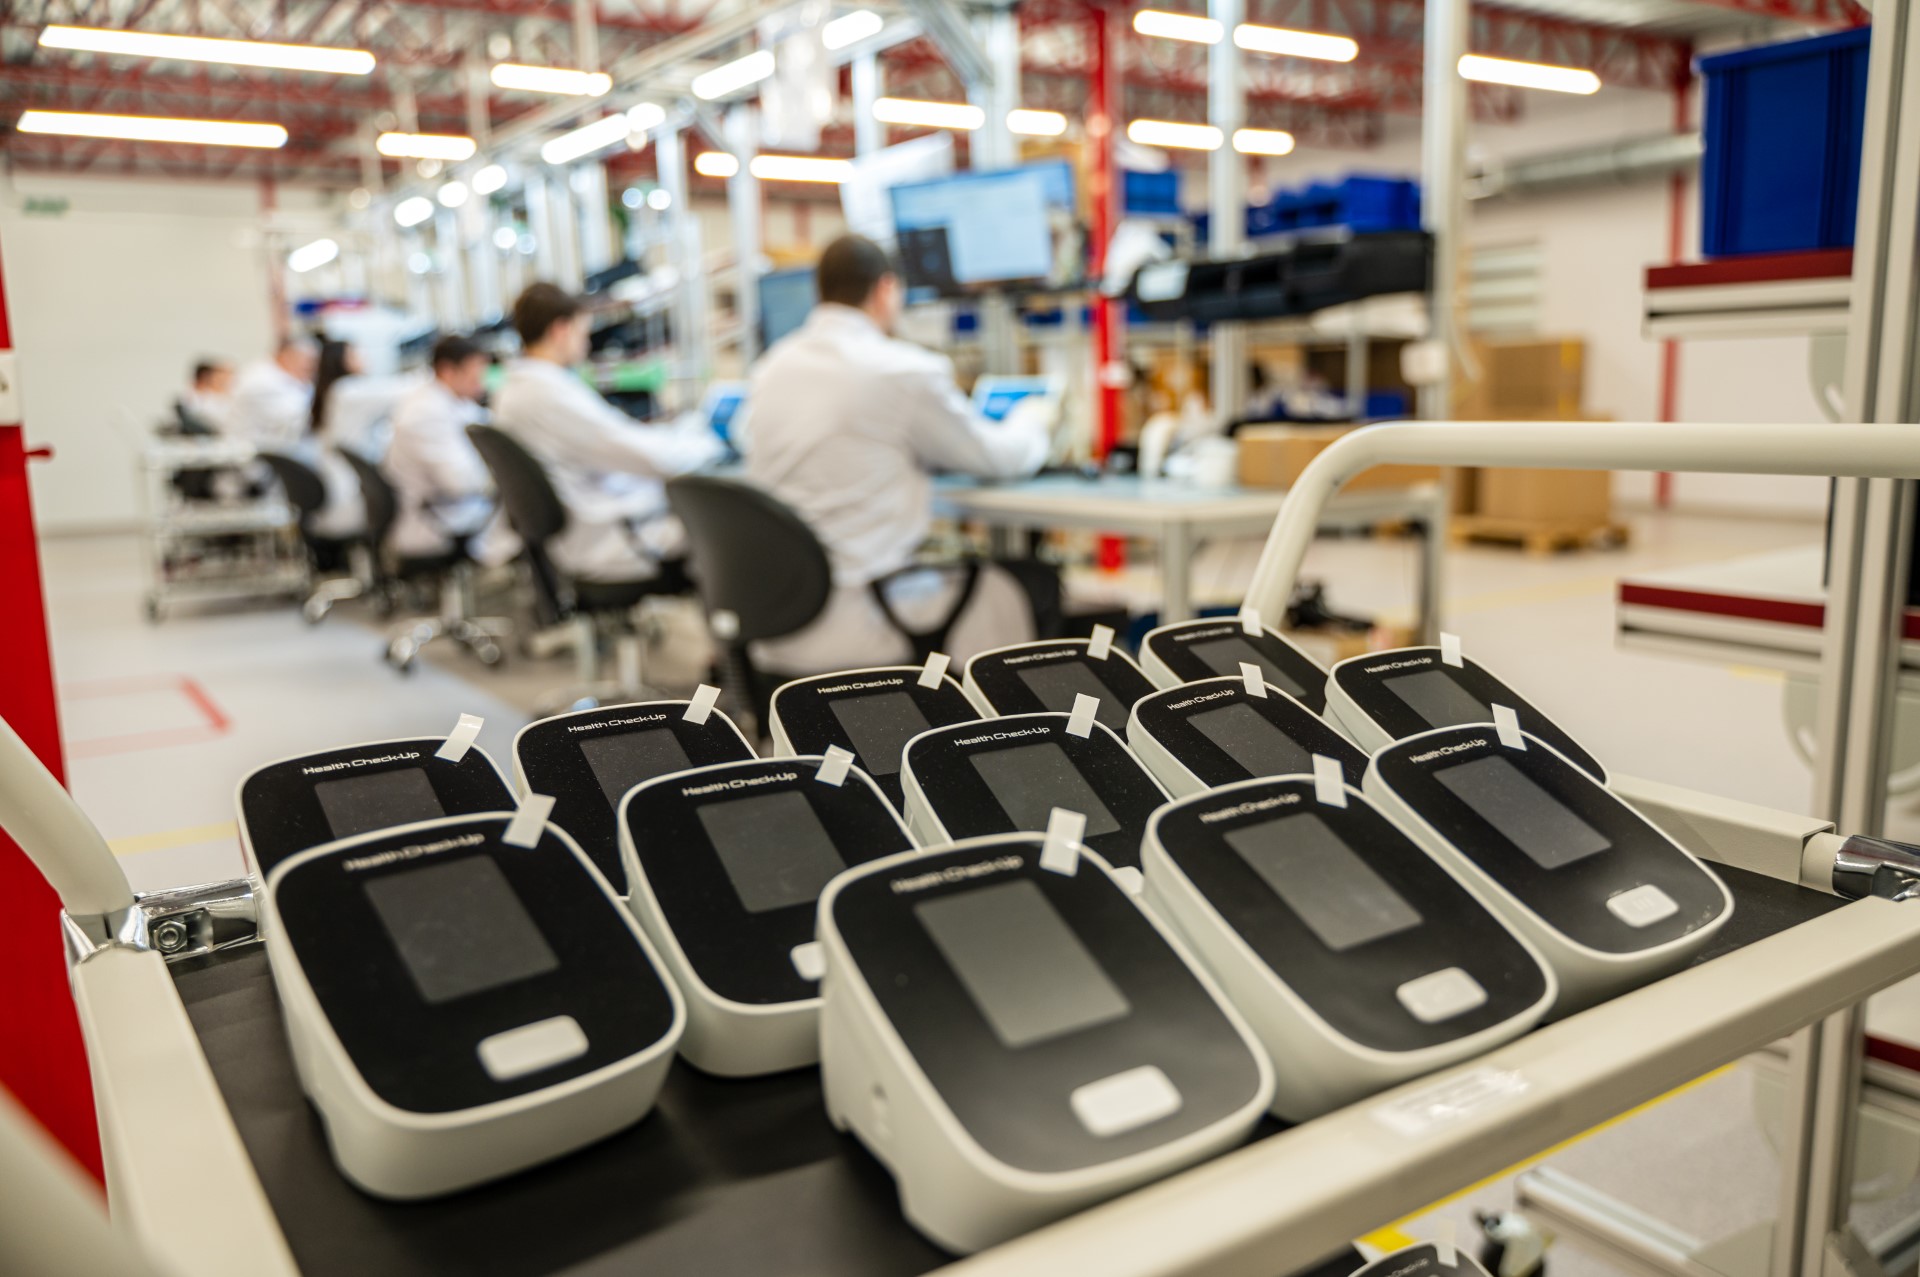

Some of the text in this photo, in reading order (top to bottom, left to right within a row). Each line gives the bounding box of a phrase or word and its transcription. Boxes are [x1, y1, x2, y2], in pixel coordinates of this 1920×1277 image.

[817, 678, 904, 694] Health Check-Up
[1167, 689, 1235, 710] Health Check-Up
[567, 714, 667, 733] Health Check-Up
[954, 727, 1050, 746] Health Check-Up
[303, 752, 420, 774] Health Check-Up
[1409, 750, 1443, 764] Health
[682, 782, 730, 797] Health
